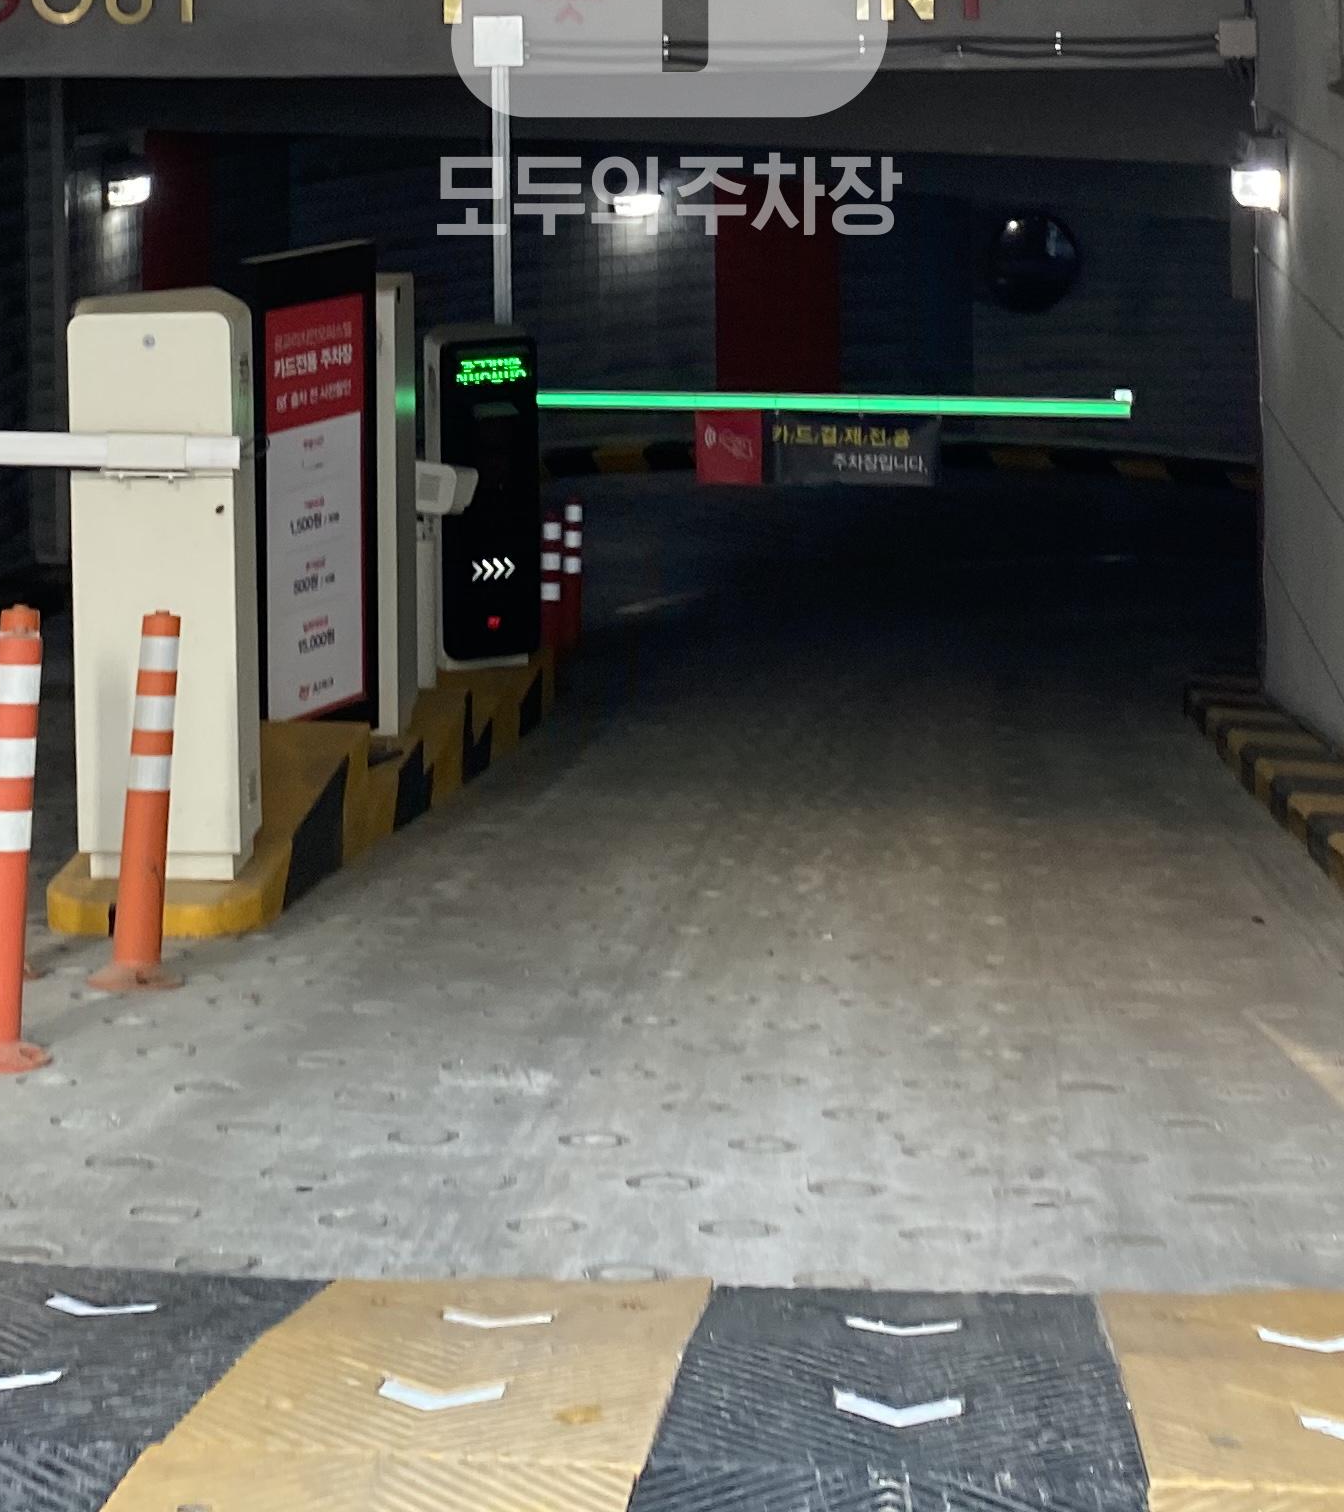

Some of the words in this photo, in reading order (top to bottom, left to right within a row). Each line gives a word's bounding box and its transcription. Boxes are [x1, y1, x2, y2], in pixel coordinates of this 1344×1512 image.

[274, 350, 318, 379] 카드전용
[320, 343, 353, 370] 주차장
[832, 451, 929, 476] 주차장입니다.
[289, 511, 322, 537] 1,500원
